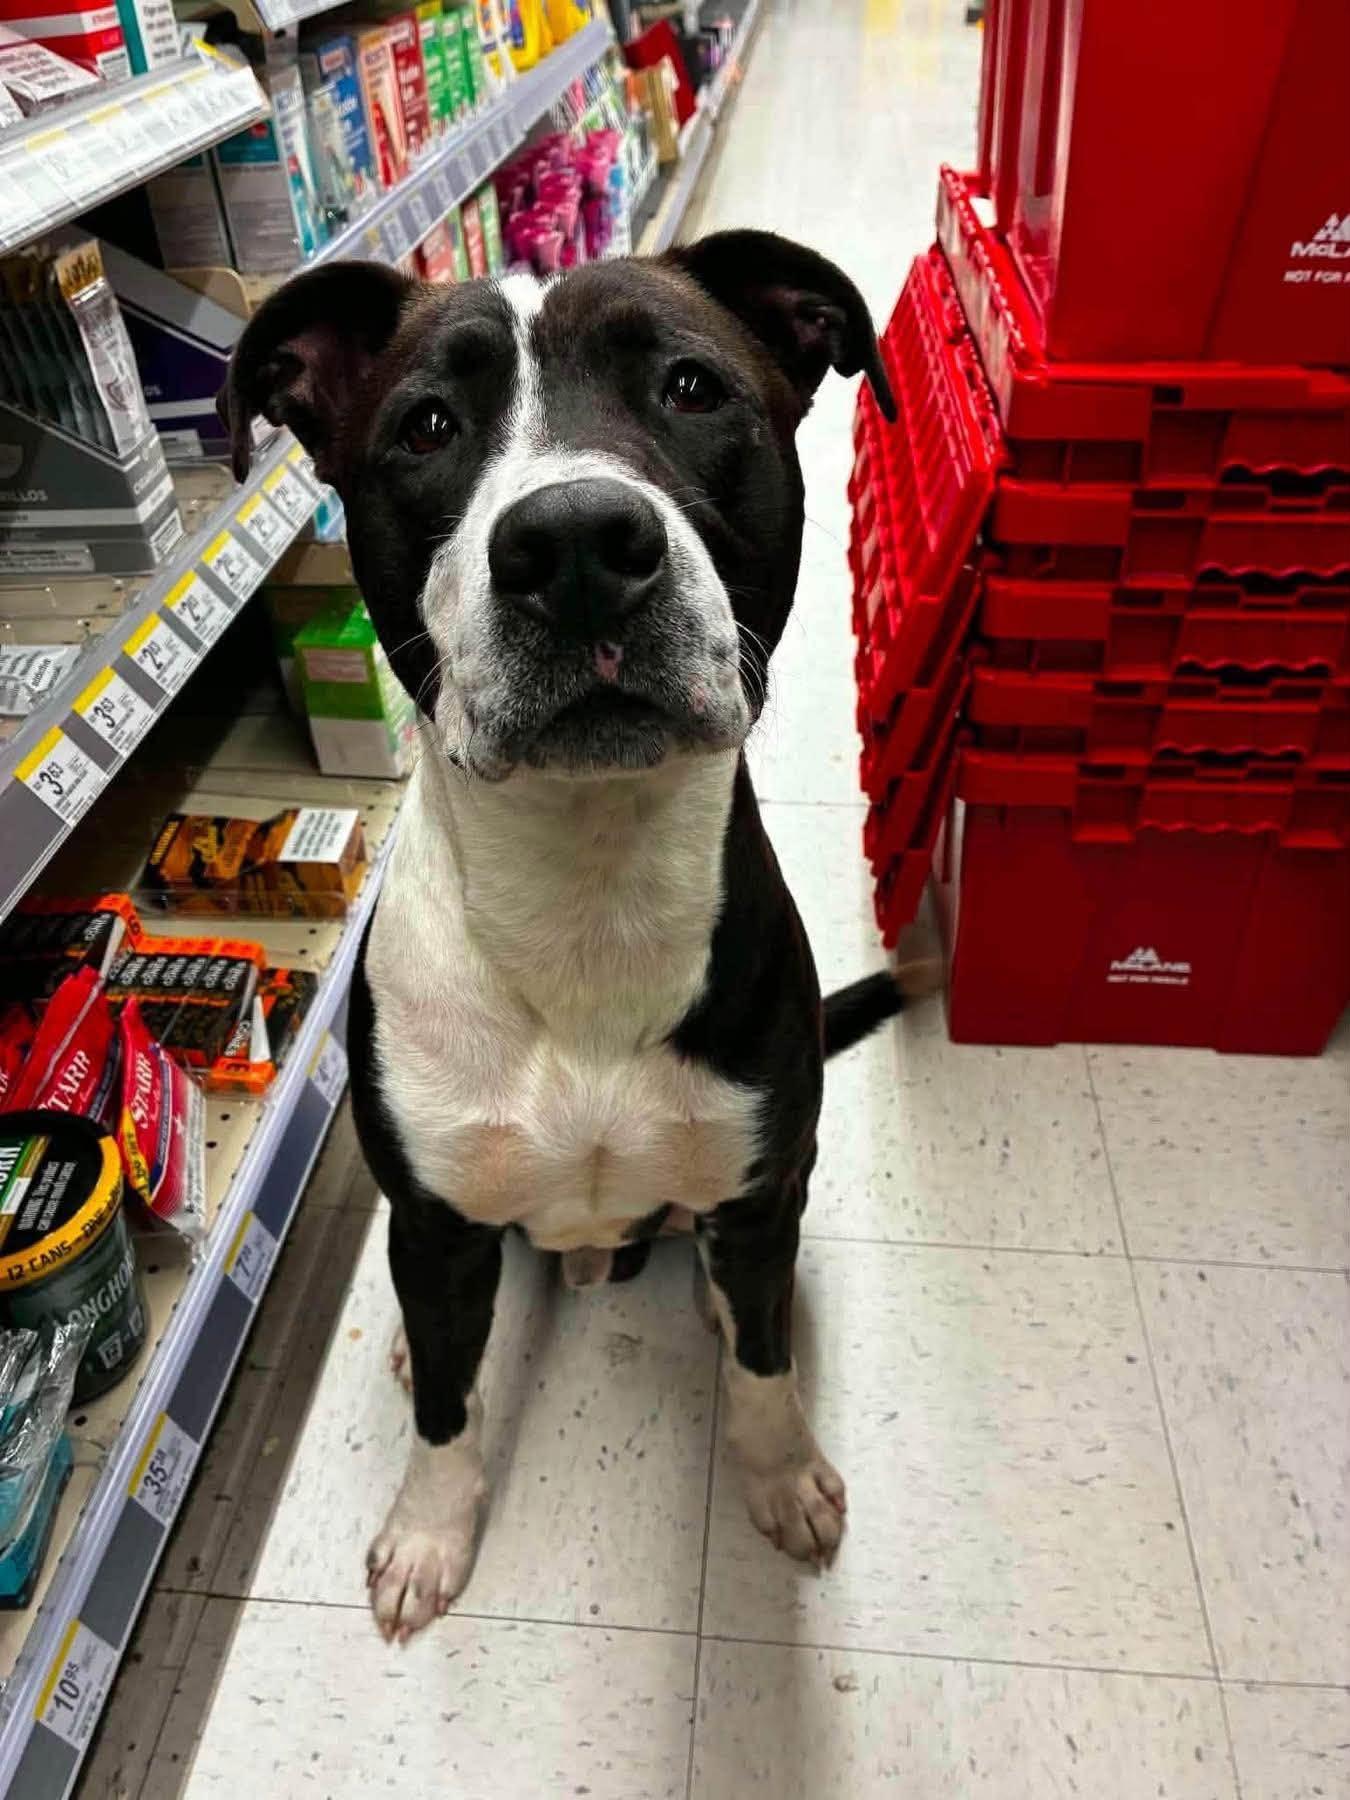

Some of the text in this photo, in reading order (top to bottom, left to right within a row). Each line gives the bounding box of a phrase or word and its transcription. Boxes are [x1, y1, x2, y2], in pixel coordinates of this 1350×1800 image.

[131, 1051, 153, 1130] STARR
[7, 1263, 25, 1281] 12
[28, 1239, 73, 1272] CANS
